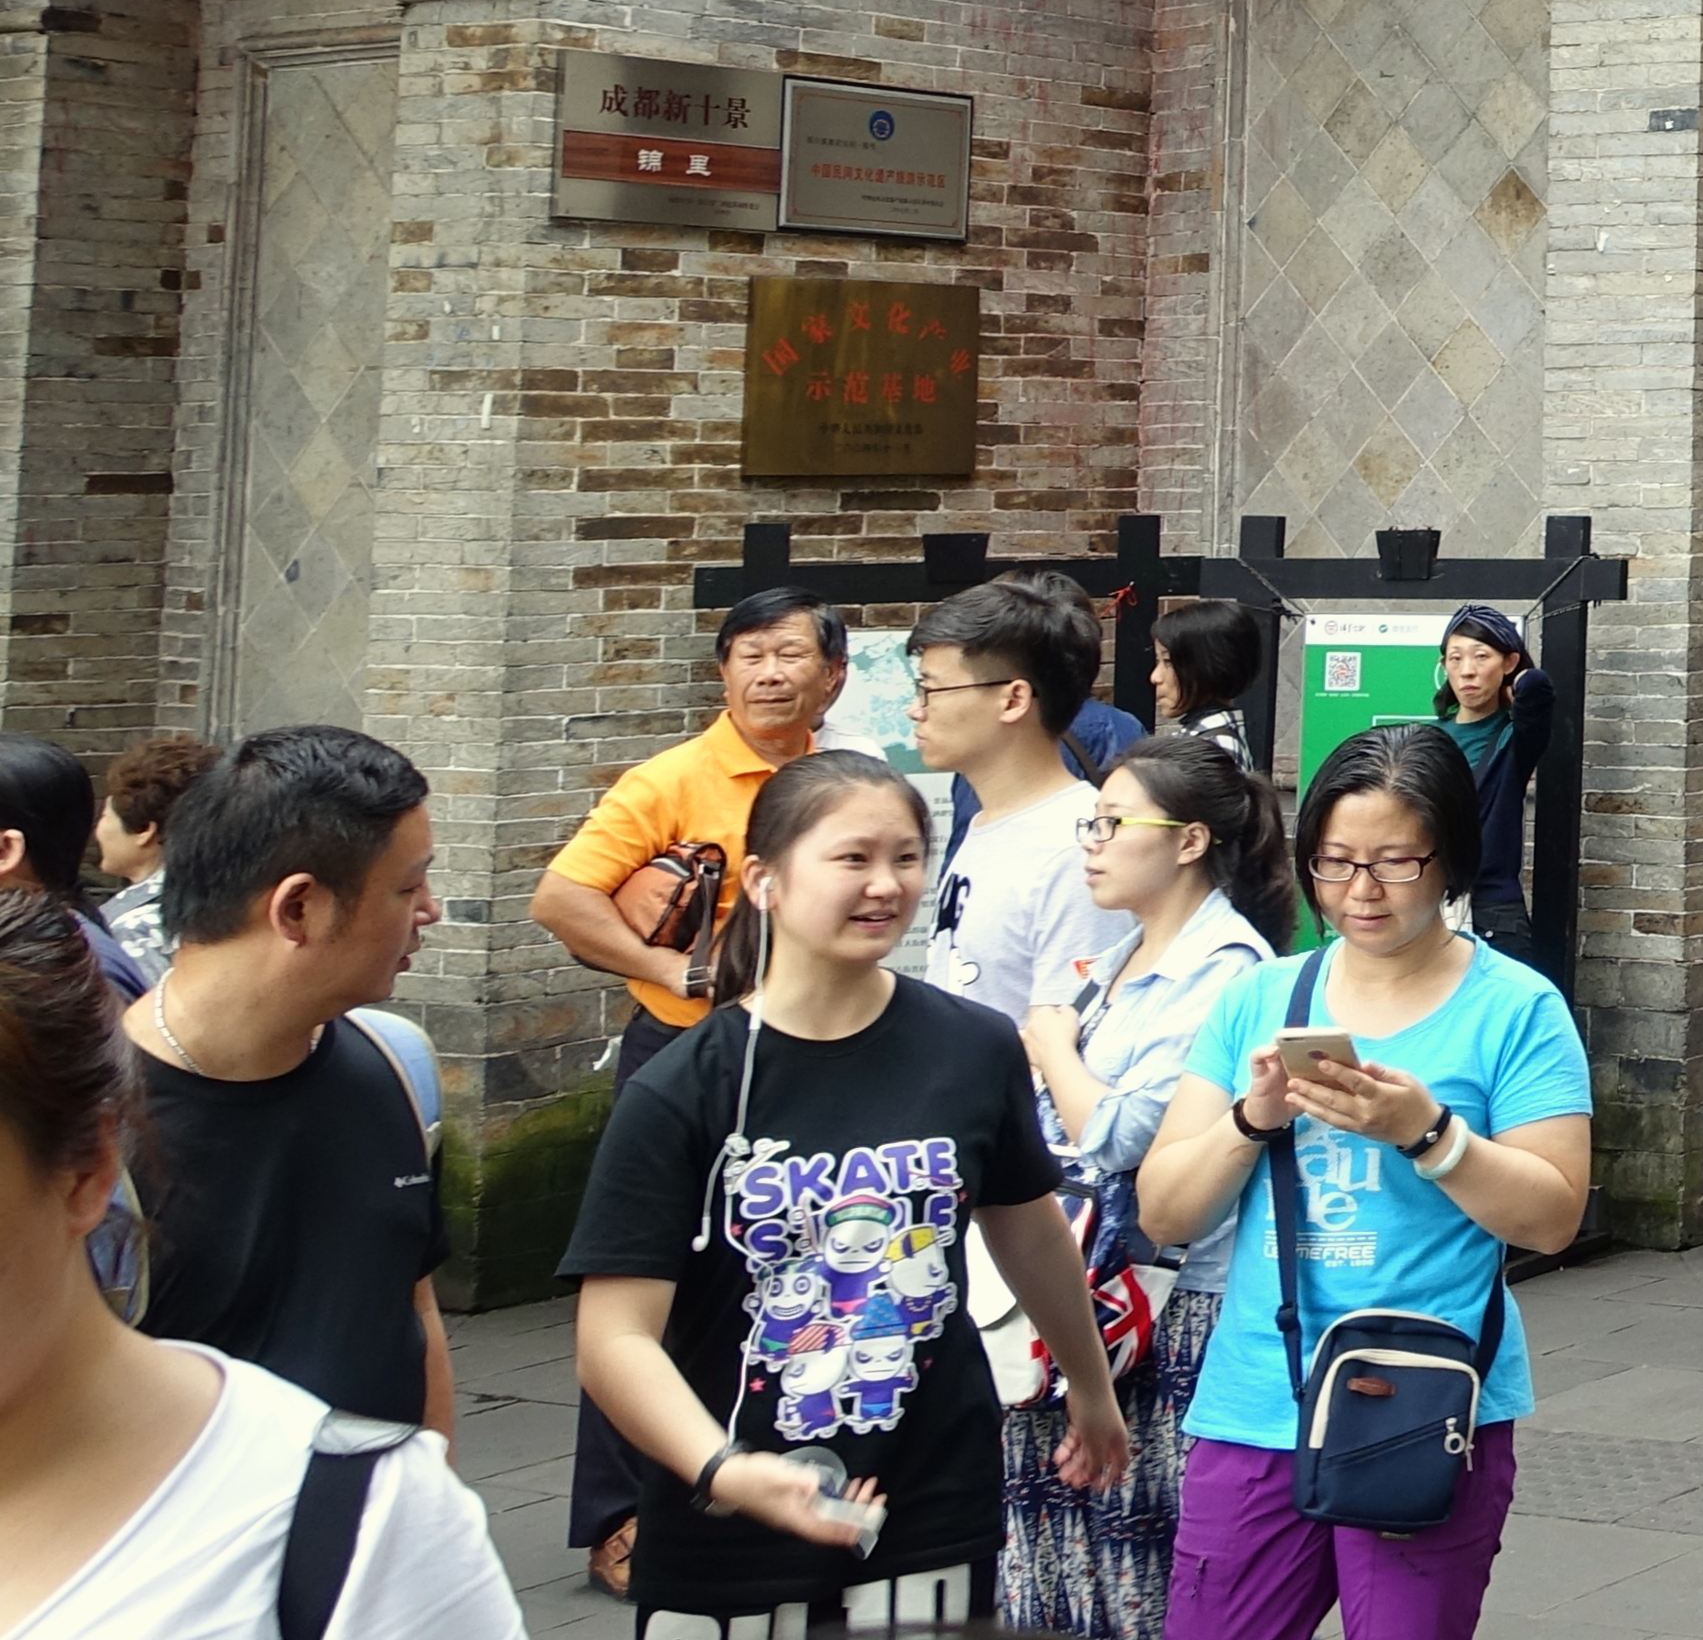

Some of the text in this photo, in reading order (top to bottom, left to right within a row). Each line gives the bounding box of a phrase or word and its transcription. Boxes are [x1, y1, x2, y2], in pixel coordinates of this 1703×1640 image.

[600, 83, 751, 130] 成都新十景
[637, 148, 712, 177] 锦里
[805, 371, 938, 404] 示范基地
[740, 1138, 958, 1219] SKATE
